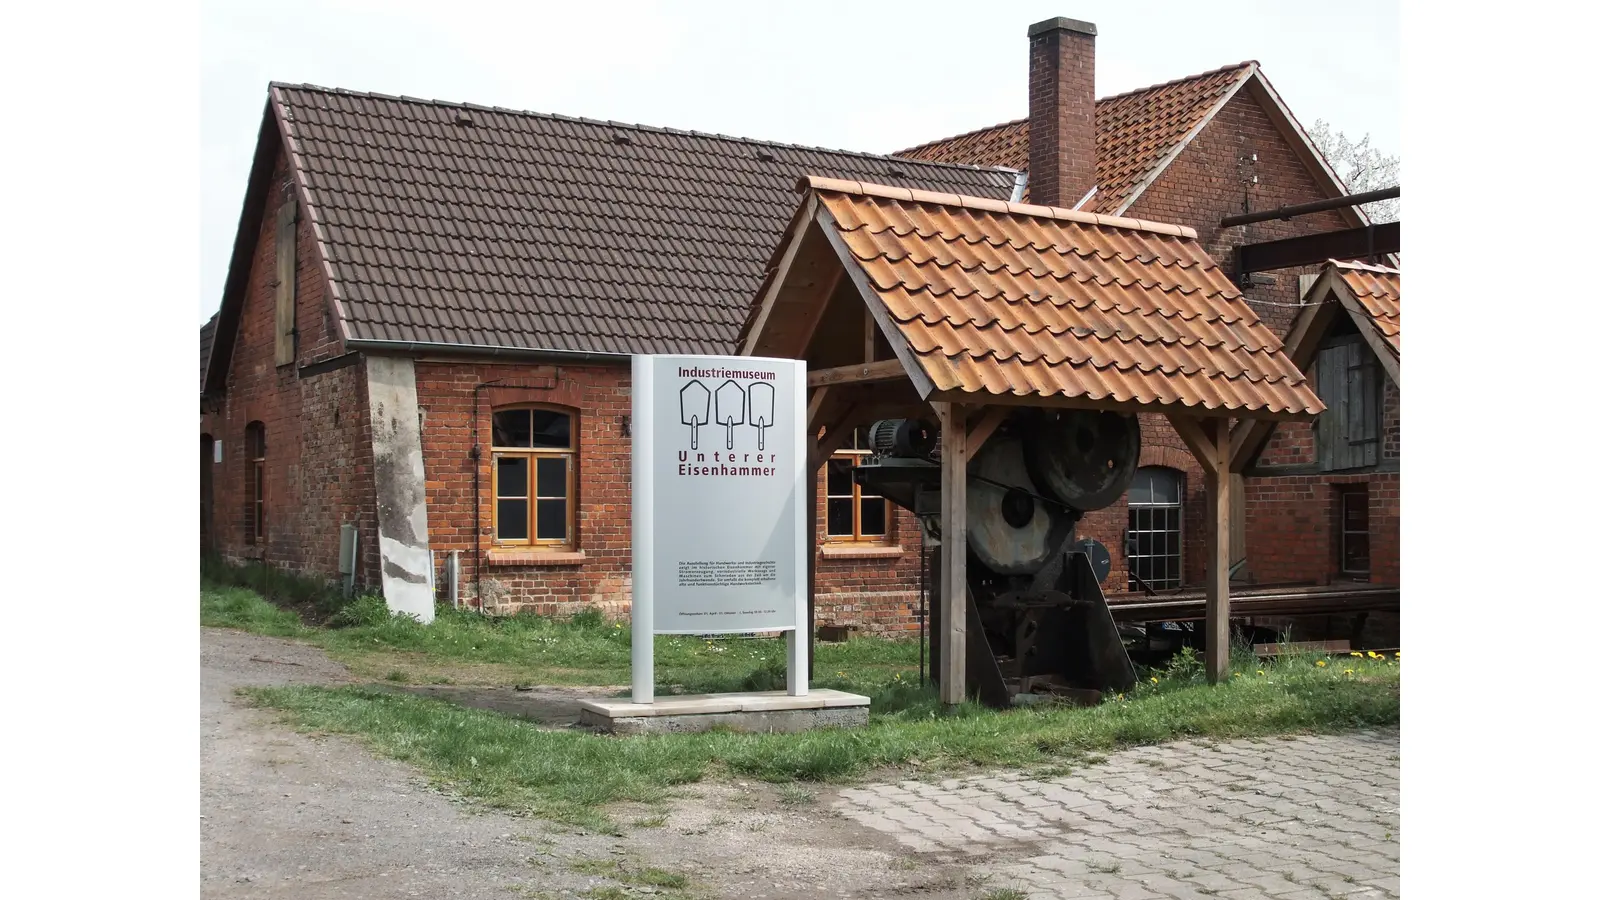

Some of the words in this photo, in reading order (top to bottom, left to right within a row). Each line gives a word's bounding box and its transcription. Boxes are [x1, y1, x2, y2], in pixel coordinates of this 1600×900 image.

[678, 366, 776, 380] Industriemuseum
[678, 450, 776, 462] Unterer
[678, 464, 776, 476] Eisenhammer
